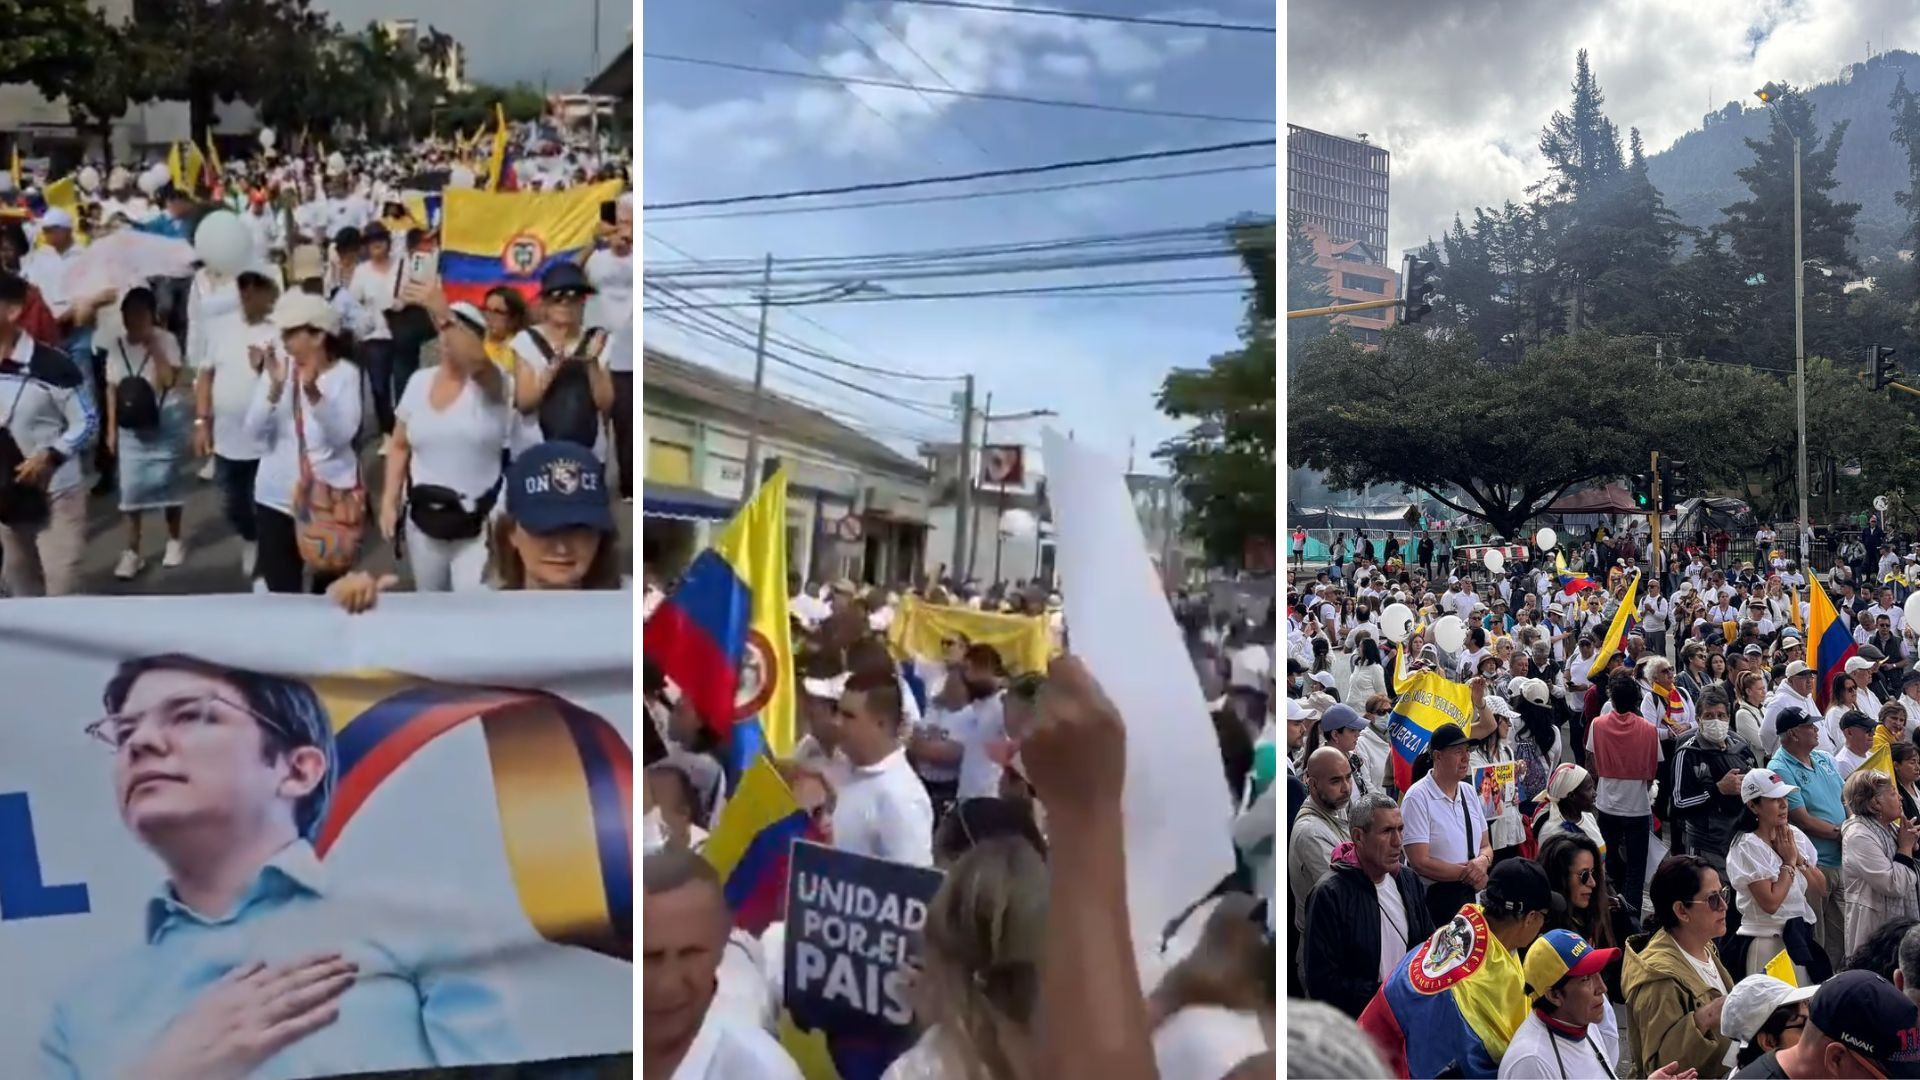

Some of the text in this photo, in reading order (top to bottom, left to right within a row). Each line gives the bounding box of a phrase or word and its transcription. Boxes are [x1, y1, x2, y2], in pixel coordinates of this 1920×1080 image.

[1388, 722, 1422, 753] FUERZA
[0, 791, 91, 921] L
[798, 871, 928, 931] UNIDAD
[804, 908, 868, 957] POR
[1841, 1031, 1875, 1054] KAVAK
